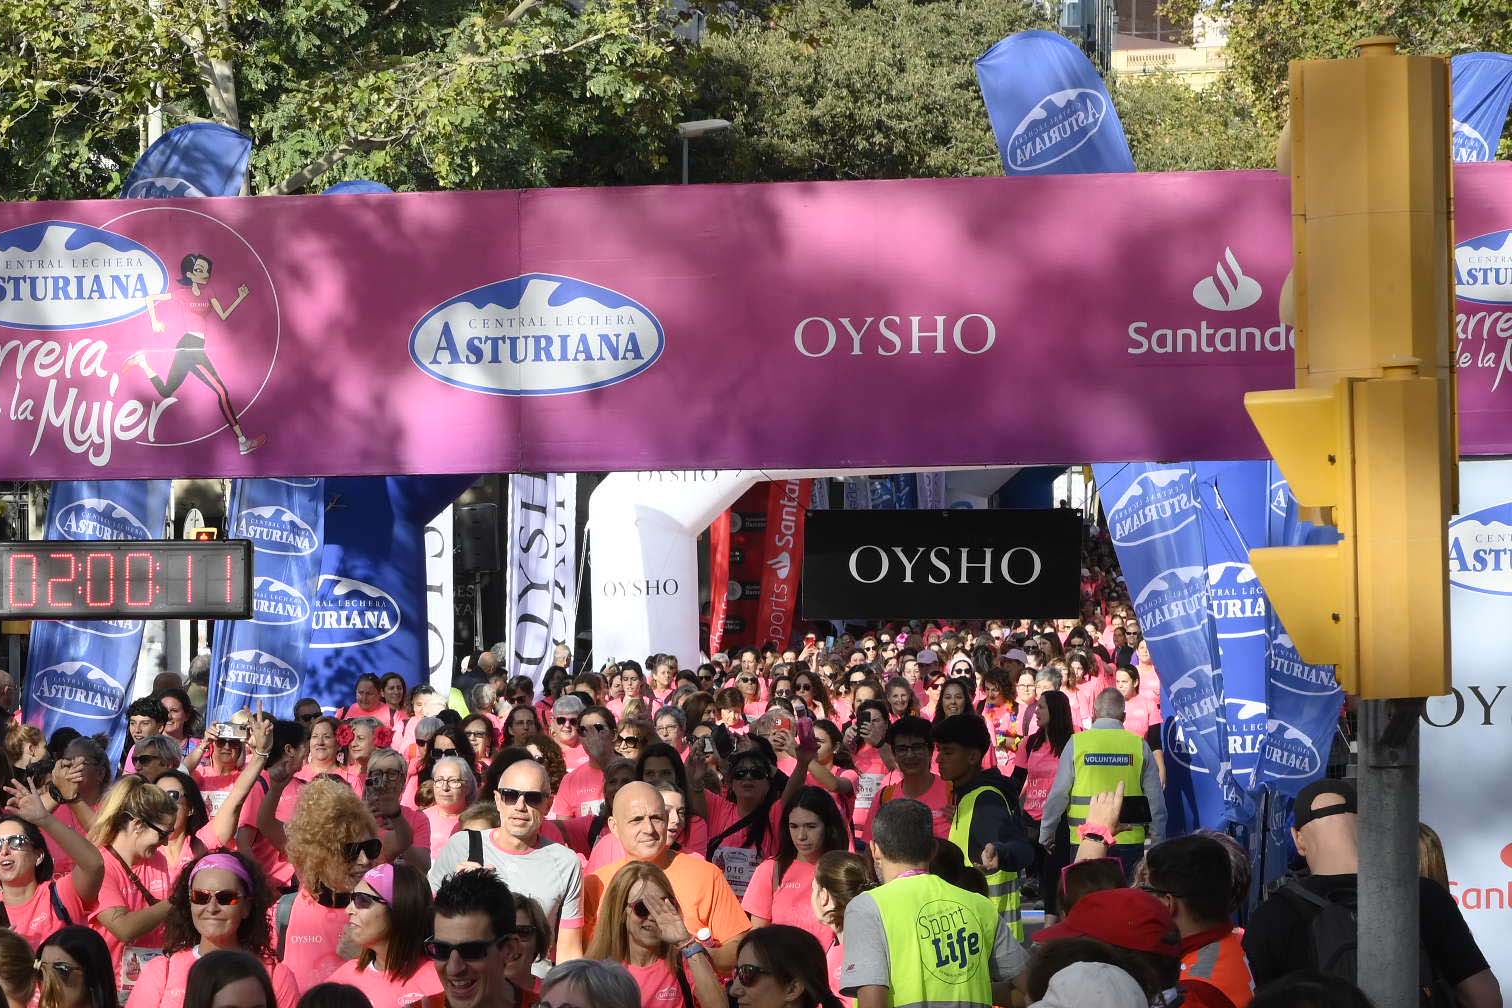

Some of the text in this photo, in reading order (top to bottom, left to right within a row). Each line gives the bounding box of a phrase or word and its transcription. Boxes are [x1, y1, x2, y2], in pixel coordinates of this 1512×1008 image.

[71, 258, 144, 270] LECHERA
[468, 313, 637, 329] CENTRAL LECHERA
[794, 313, 997, 358] OYSHO
[428, 320, 644, 366] ASTURIANA
[1478, 341, 1496, 368] la
[9, 382, 35, 421] la
[29, 370, 180, 467] Mujer
[236, 517, 311, 550] ASTURIANA
[848, 545, 1042, 586] OYSHO
[602, 577, 679, 598] OYSHO
[1209, 597, 1266, 619] URIA
[37, 677, 120, 712] ASTURIANA
[1421, 685, 1512, 728] OY
[1085, 756, 1128, 771] VOLUNTARIS
[726, 866, 745, 874] 016
[918, 904, 968, 940] Sport
[290, 934, 323, 944] OYSHO
[931, 927, 981, 969] Life
